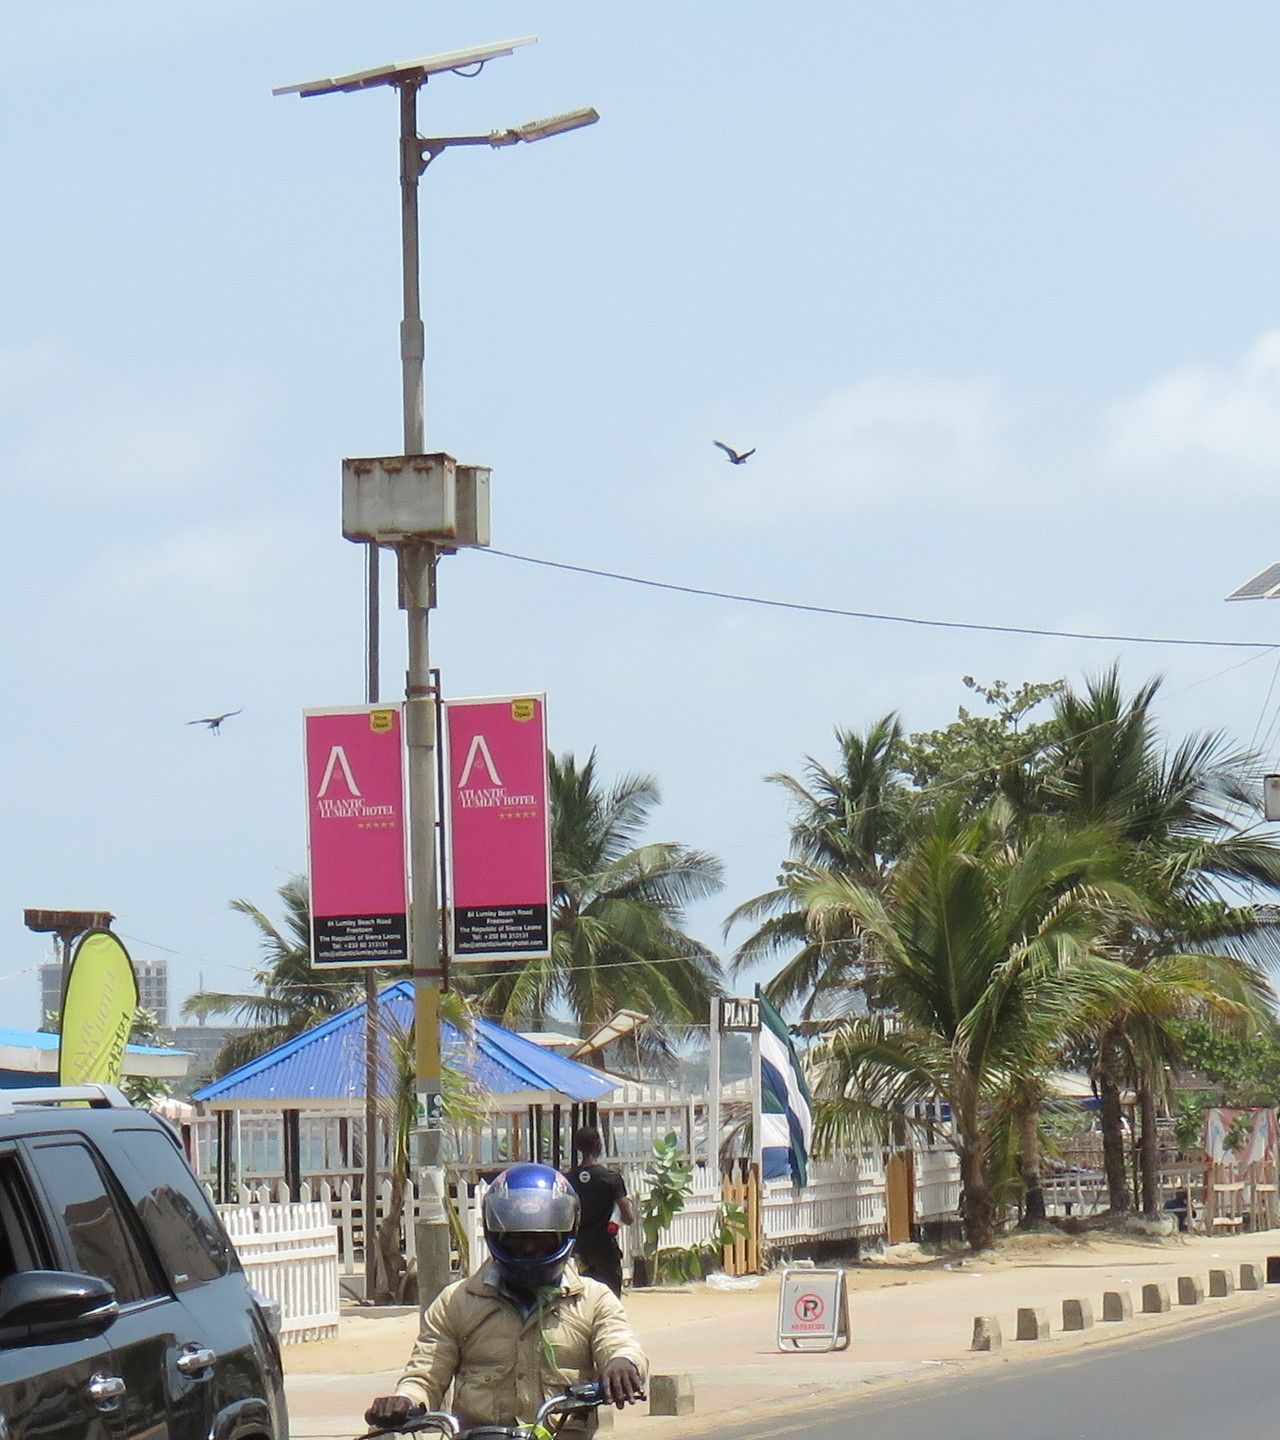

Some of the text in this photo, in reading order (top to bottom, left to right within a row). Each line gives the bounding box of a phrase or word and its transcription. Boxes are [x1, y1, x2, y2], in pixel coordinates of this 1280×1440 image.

[459, 788, 506, 800] ATLANTIC
[318, 799, 365, 810] ATLANTIC
[462, 795, 537, 808] LUMLEY HOTEL
[321, 805, 395, 818] LUMLEY HOTEL
[723, 1002, 759, 1027] PLAN B
